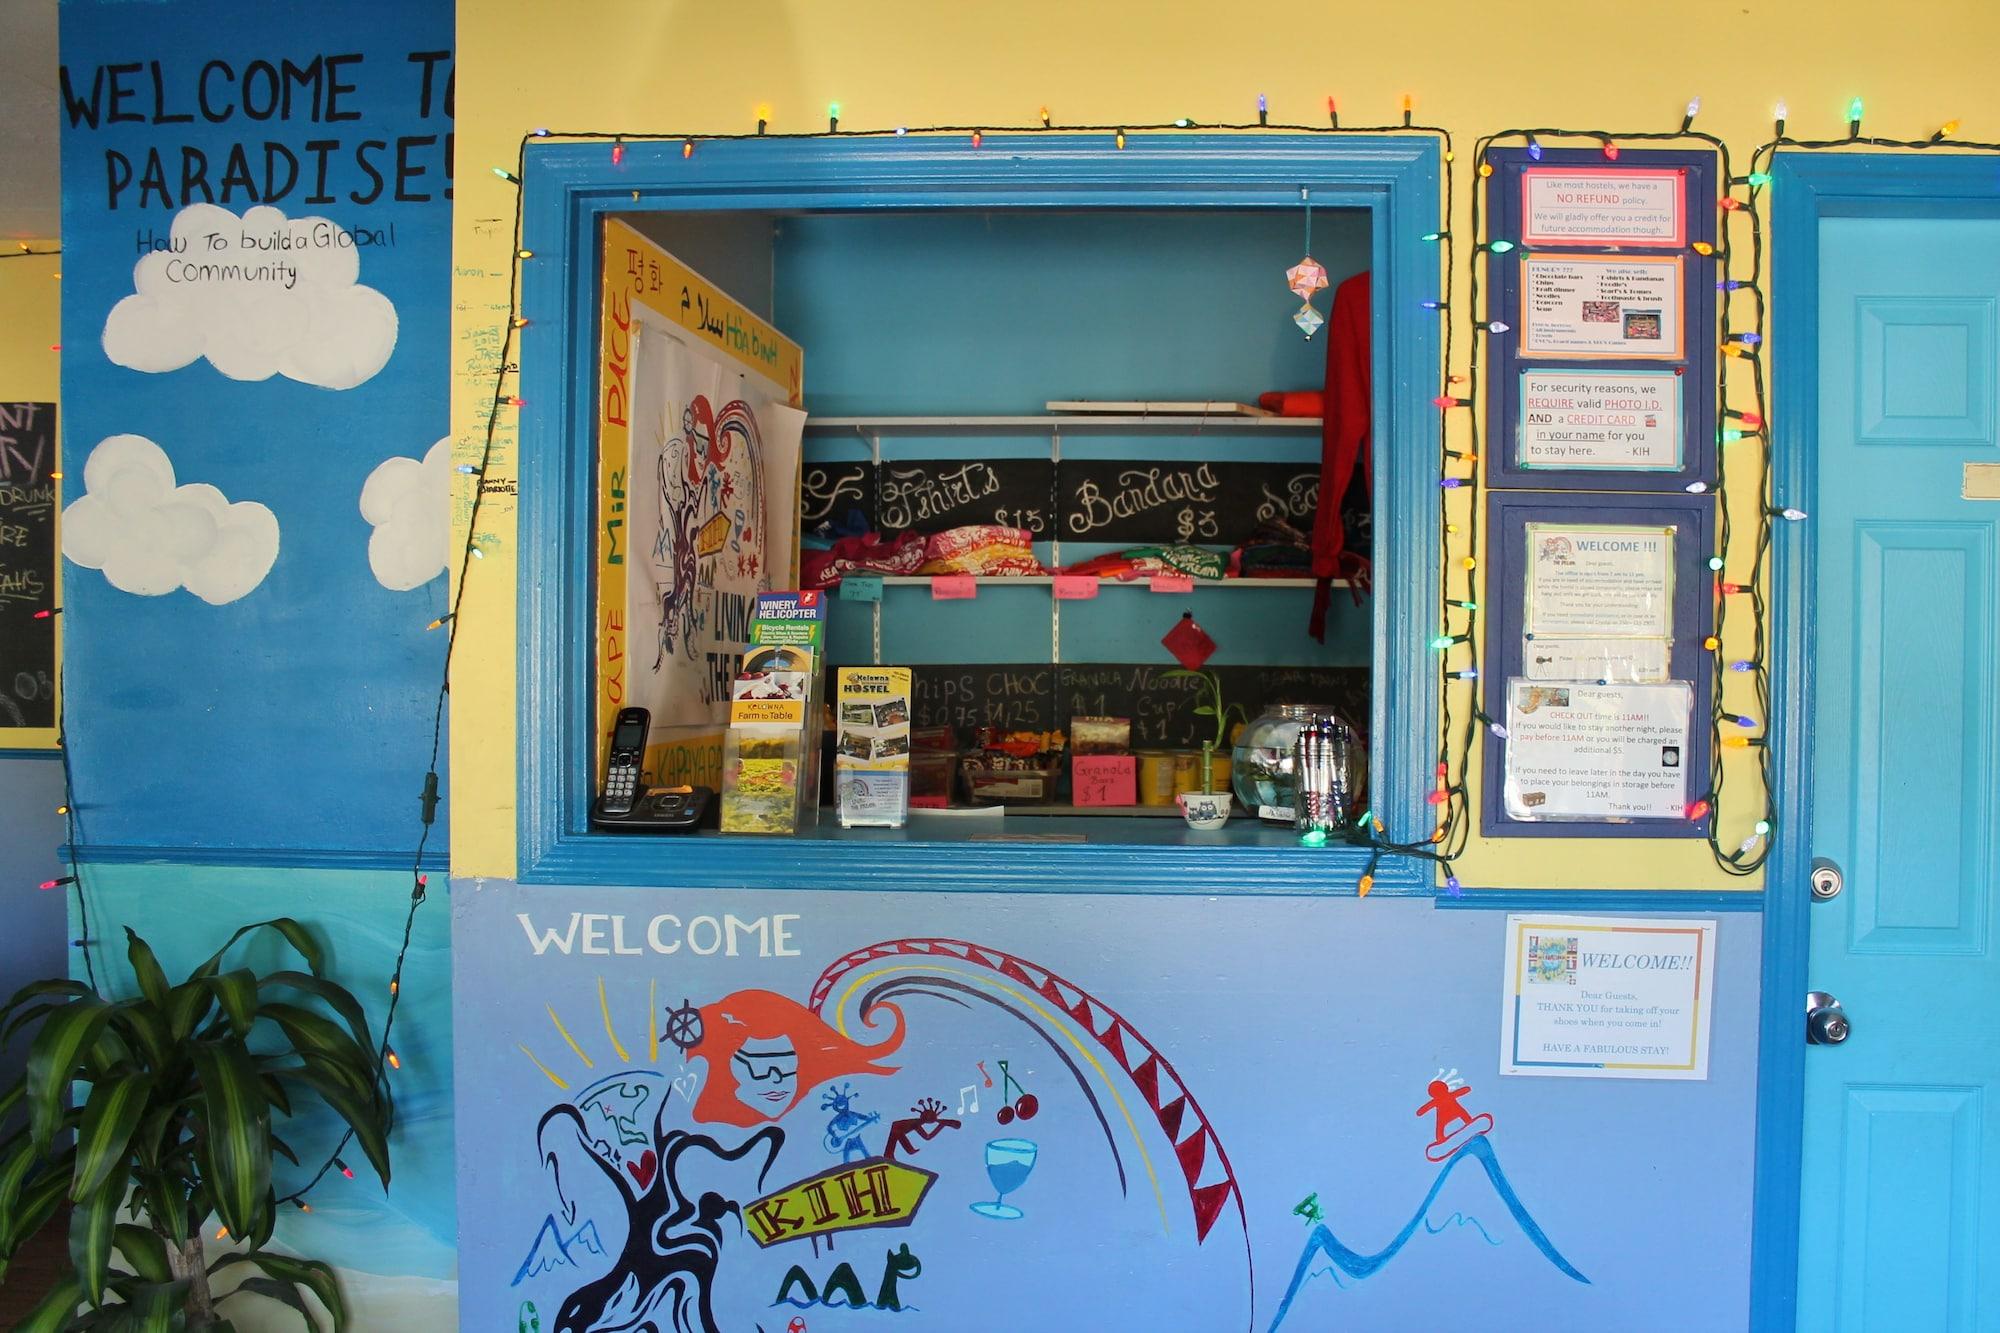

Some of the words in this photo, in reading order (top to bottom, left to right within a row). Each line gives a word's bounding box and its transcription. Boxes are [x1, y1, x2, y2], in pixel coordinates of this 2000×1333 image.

[60, 54, 363, 129] WELCOME
[106, 134, 455, 210] PARADISE!
[1546, 181, 1561, 189] Like
[1586, 182, 1615, 190] hostels,
[1632, 182, 1650, 190] have
[1557, 194, 1573, 203] NO
[1576, 194, 1619, 203] REFUND
[1622, 197, 1647, 205] policy.
[1565, 213, 1588, 222] gladly
[1634, 214, 1657, 222] credit
[1542, 224, 1565, 232] future
[1568, 225, 1631, 233] accommodation
[1633, 226, 1663, 234] though.
[137, 227, 187, 254] How
[205, 232, 228, 251] To
[240, 223, 292, 252] build
[312, 222, 397, 251] Global
[166, 259, 298, 290] Community
[1531, 383, 1547, 392] For
[1551, 383, 1591, 394] security
[1595, 384, 1638, 394] reasons,
[1528, 399, 1574, 408] REQUIRE
[1577, 399, 1601, 408] valid
[1605, 400, 1641, 409] PHOTO
[1528, 414, 1552, 424] AND
[1567, 415, 1605, 424] CREDIT
[1607, 416, 1635, 424] CARD
[1537, 431, 1546, 439] in
[1608, 431, 1622, 440] for
[1626, 433, 1644, 441] you
[1531, 447, 1541, 455] to
[1545, 447, 1565, 456] stay
[1569, 446, 1595, 455] here.
[1632, 447, 1650, 456] KIH
[1069, 463, 1220, 534] Bandana
[1576, 541, 1639, 552] WELCOME
[1644, 542, 1656, 552] !!!
[760, 600, 797, 610] WINERY
[759, 609, 816, 619] HELICOPTER
[844, 684, 890, 694] HOSTEL
[1578, 690, 1595, 698] Dear
[1597, 691, 1623, 699] guests,
[738, 712, 760, 720] Farm
[770, 711, 793, 720] Table
[1588, 725, 1603, 733] stay
[1636, 726, 1657, 734] night,
[1659, 727, 1682, 735] please
[1638, 737, 1666, 745] charged
[1574, 746, 1611, 754] additional
[1074, 761, 1131, 777] Granola
[1522, 768, 1536, 776] you
[1538, 767, 1557, 775] need
[1569, 768, 1588, 776] leave
[1633, 770, 1646, 778] day
[1648, 771, 1661, 779] you
[1530, 779, 1549, 787] place
[1571, 779, 1611, 789] belongings
[1622, 782, 1648, 790] storage
[1609, 803, 1631, 811] Thank
[517, 912, 800, 957] WELCOME
[1582, 953, 1693, 970] WELCOME!!
[1581, 991, 1601, 999] Dear
[1605, 992, 1638, 1001] Guests,
[1537, 1003, 1573, 1012] THANK
[1576, 1004, 1598, 1013] YOU
[1600, 1004, 1612, 1013] for
[1615, 1005, 1643, 1015] taking
[1646, 1006, 1659, 1014] off
[1660, 1008, 1679, 1016] your
[1554, 1017, 1578, 1025] shoes
[1581, 1018, 1604, 1026] when
[1607, 1020, 1623, 1028] you
[1625, 1020, 1647, 1028] come
[1650, 1020, 1661, 1028] in!
[1543, 1043, 1571, 1052] HAVE
[1573, 1044, 1580, 1052] A
[1584, 1045, 1638, 1054] FABULOUS
[1641, 1046, 1669, 1055] STAY!
[749, 1165, 900, 1243] KIH
